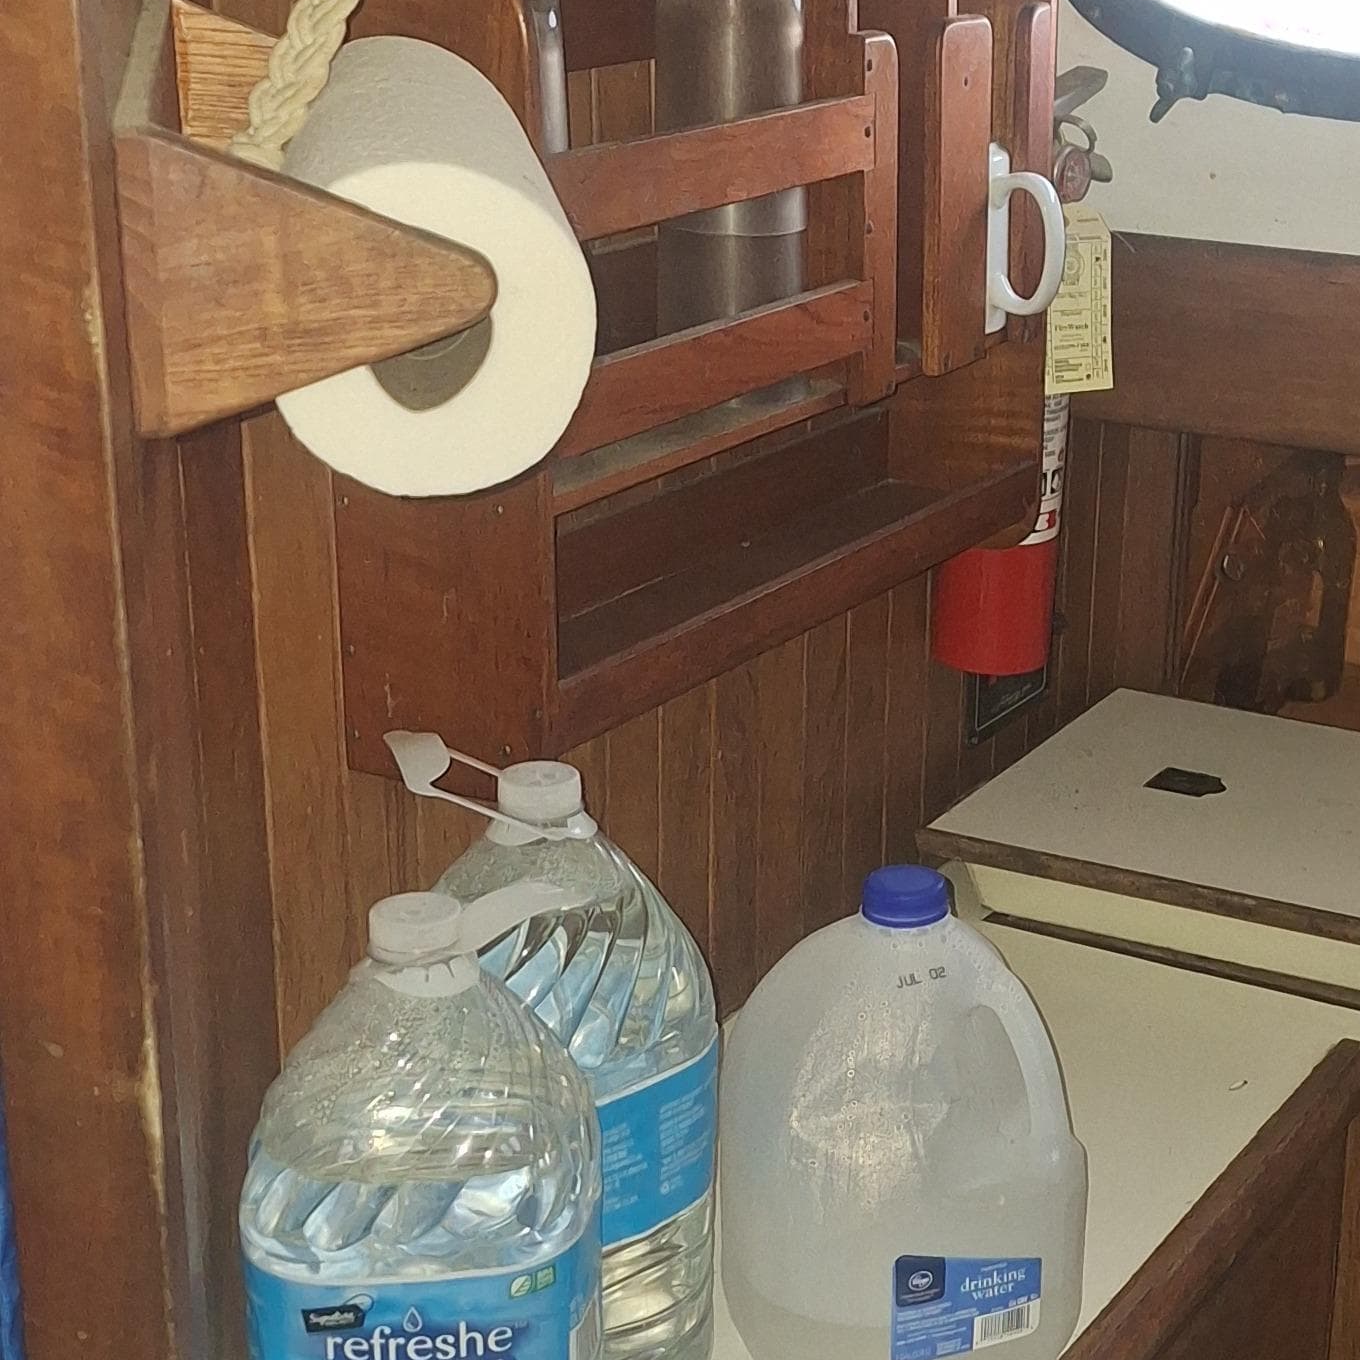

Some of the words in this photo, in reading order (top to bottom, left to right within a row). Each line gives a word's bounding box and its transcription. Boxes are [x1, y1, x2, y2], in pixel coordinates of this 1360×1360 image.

[896, 972, 923, 989] JUL
[928, 966, 948, 980] 02
[961, 1267, 1027, 1293] drinking
[971, 1281, 1015, 1301] water
